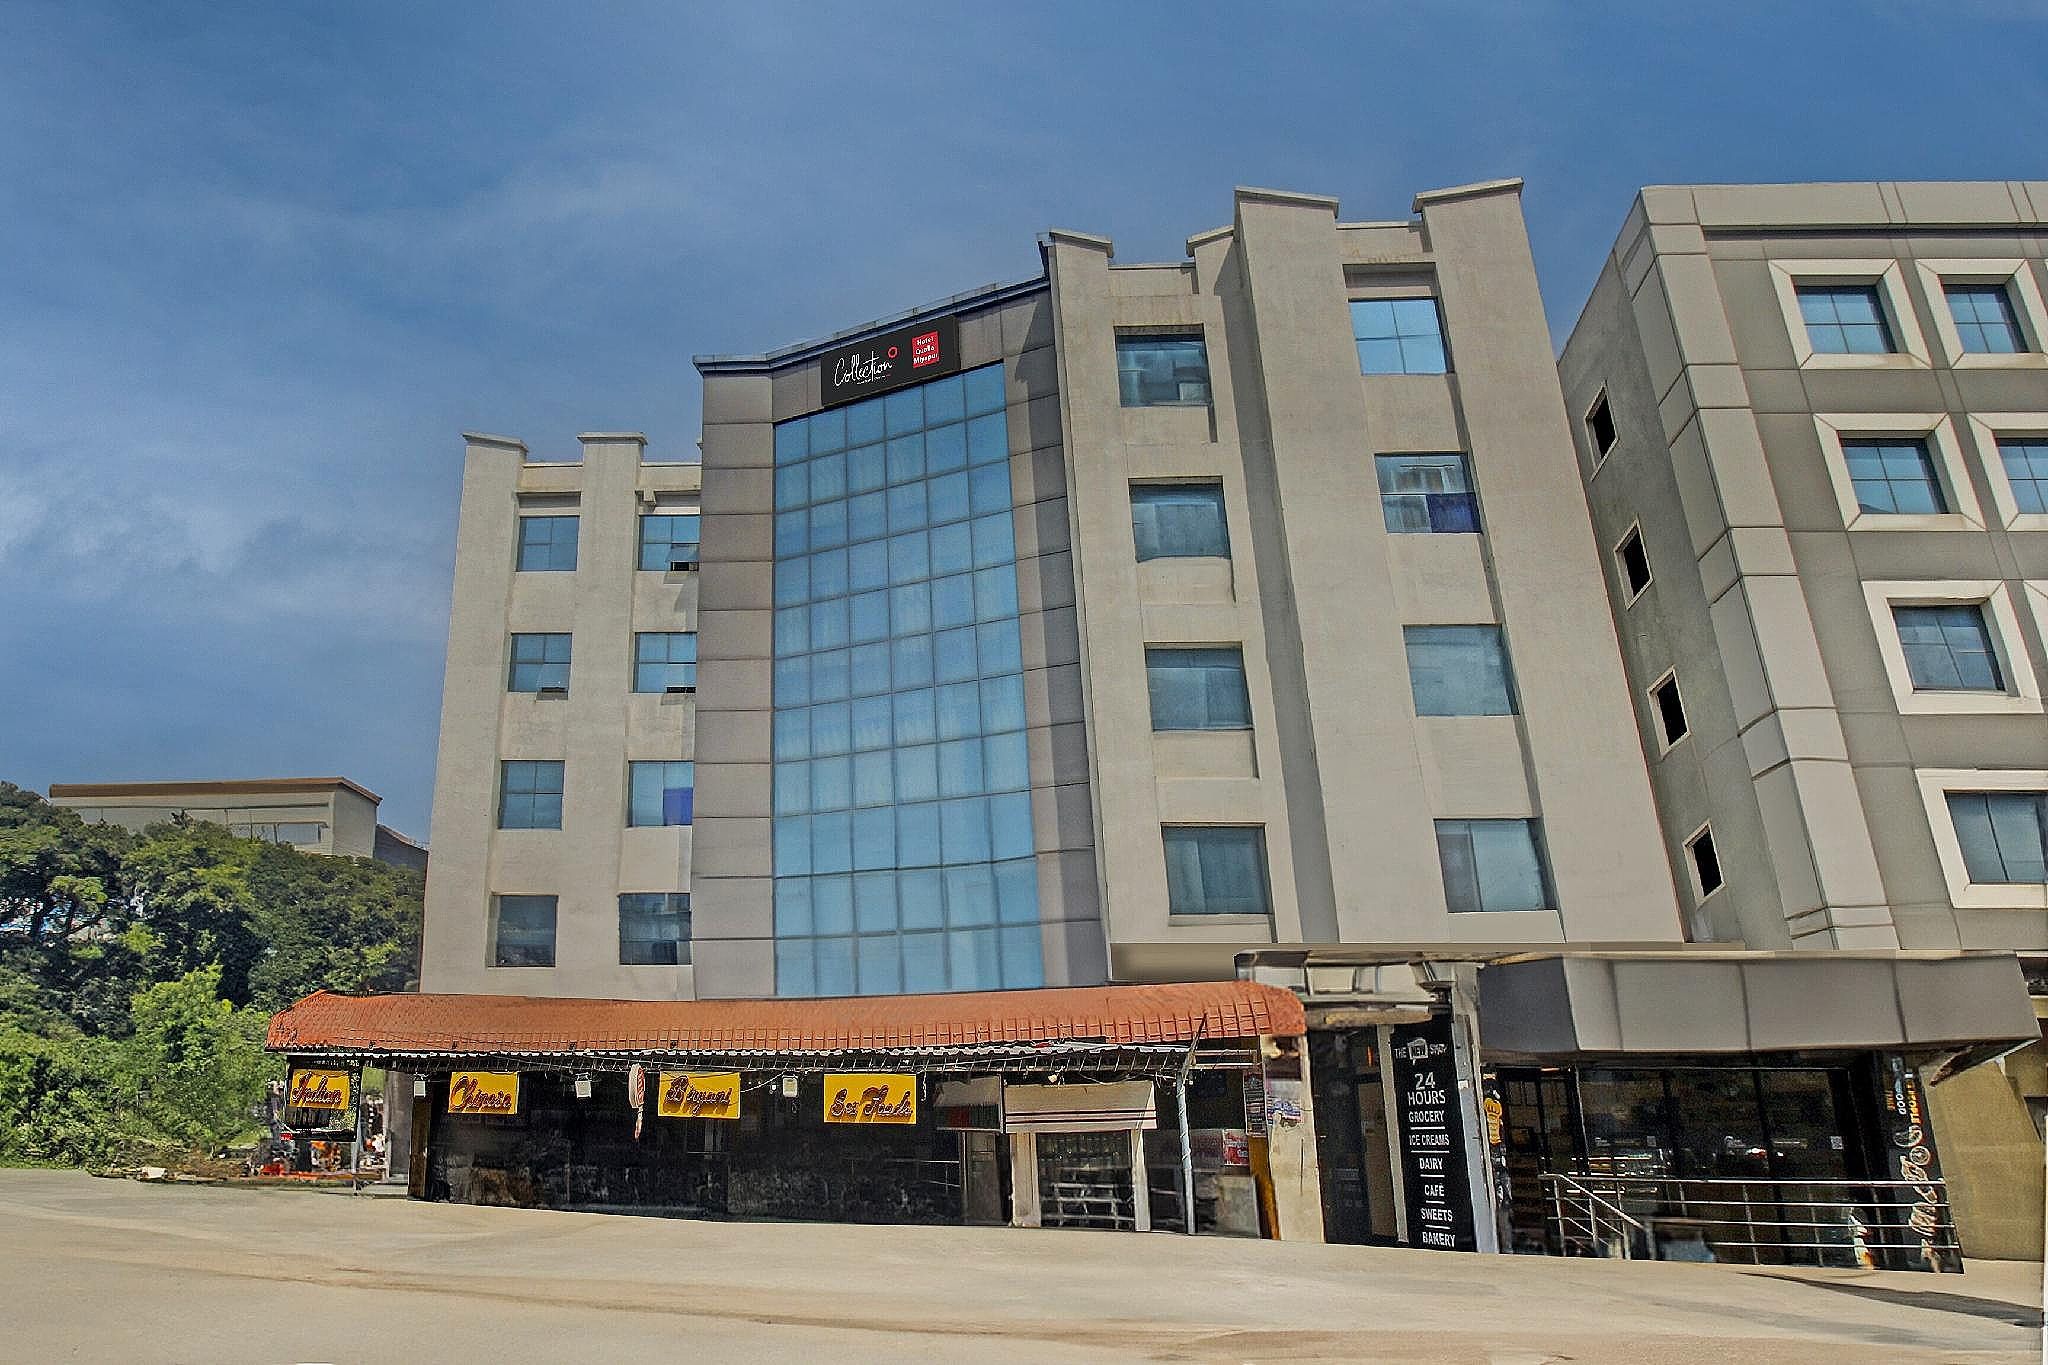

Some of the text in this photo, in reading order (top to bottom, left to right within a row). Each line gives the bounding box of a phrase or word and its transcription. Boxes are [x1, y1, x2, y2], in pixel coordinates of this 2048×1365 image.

[916, 335, 935, 346] Hotel
[834, 351, 893, 386] Collection
[1394, 1046, 1407, 1059] THE
[291, 1070, 343, 1104] Indian
[1414, 1071, 1436, 1091] 24
[451, 1075, 512, 1111] Chinese
[663, 1075, 733, 1116] Biryani
[1407, 1089, 1446, 1106] HOURS
[1408, 1110, 1445, 1123] GROCERY
[1408, 1133, 1450, 1146] ICE CREAMS
[1419, 1157, 1443, 1170] DAIRY
[1420, 1207, 1453, 1222] SWEETS
[1422, 1231, 1456, 1248] BAKERY
